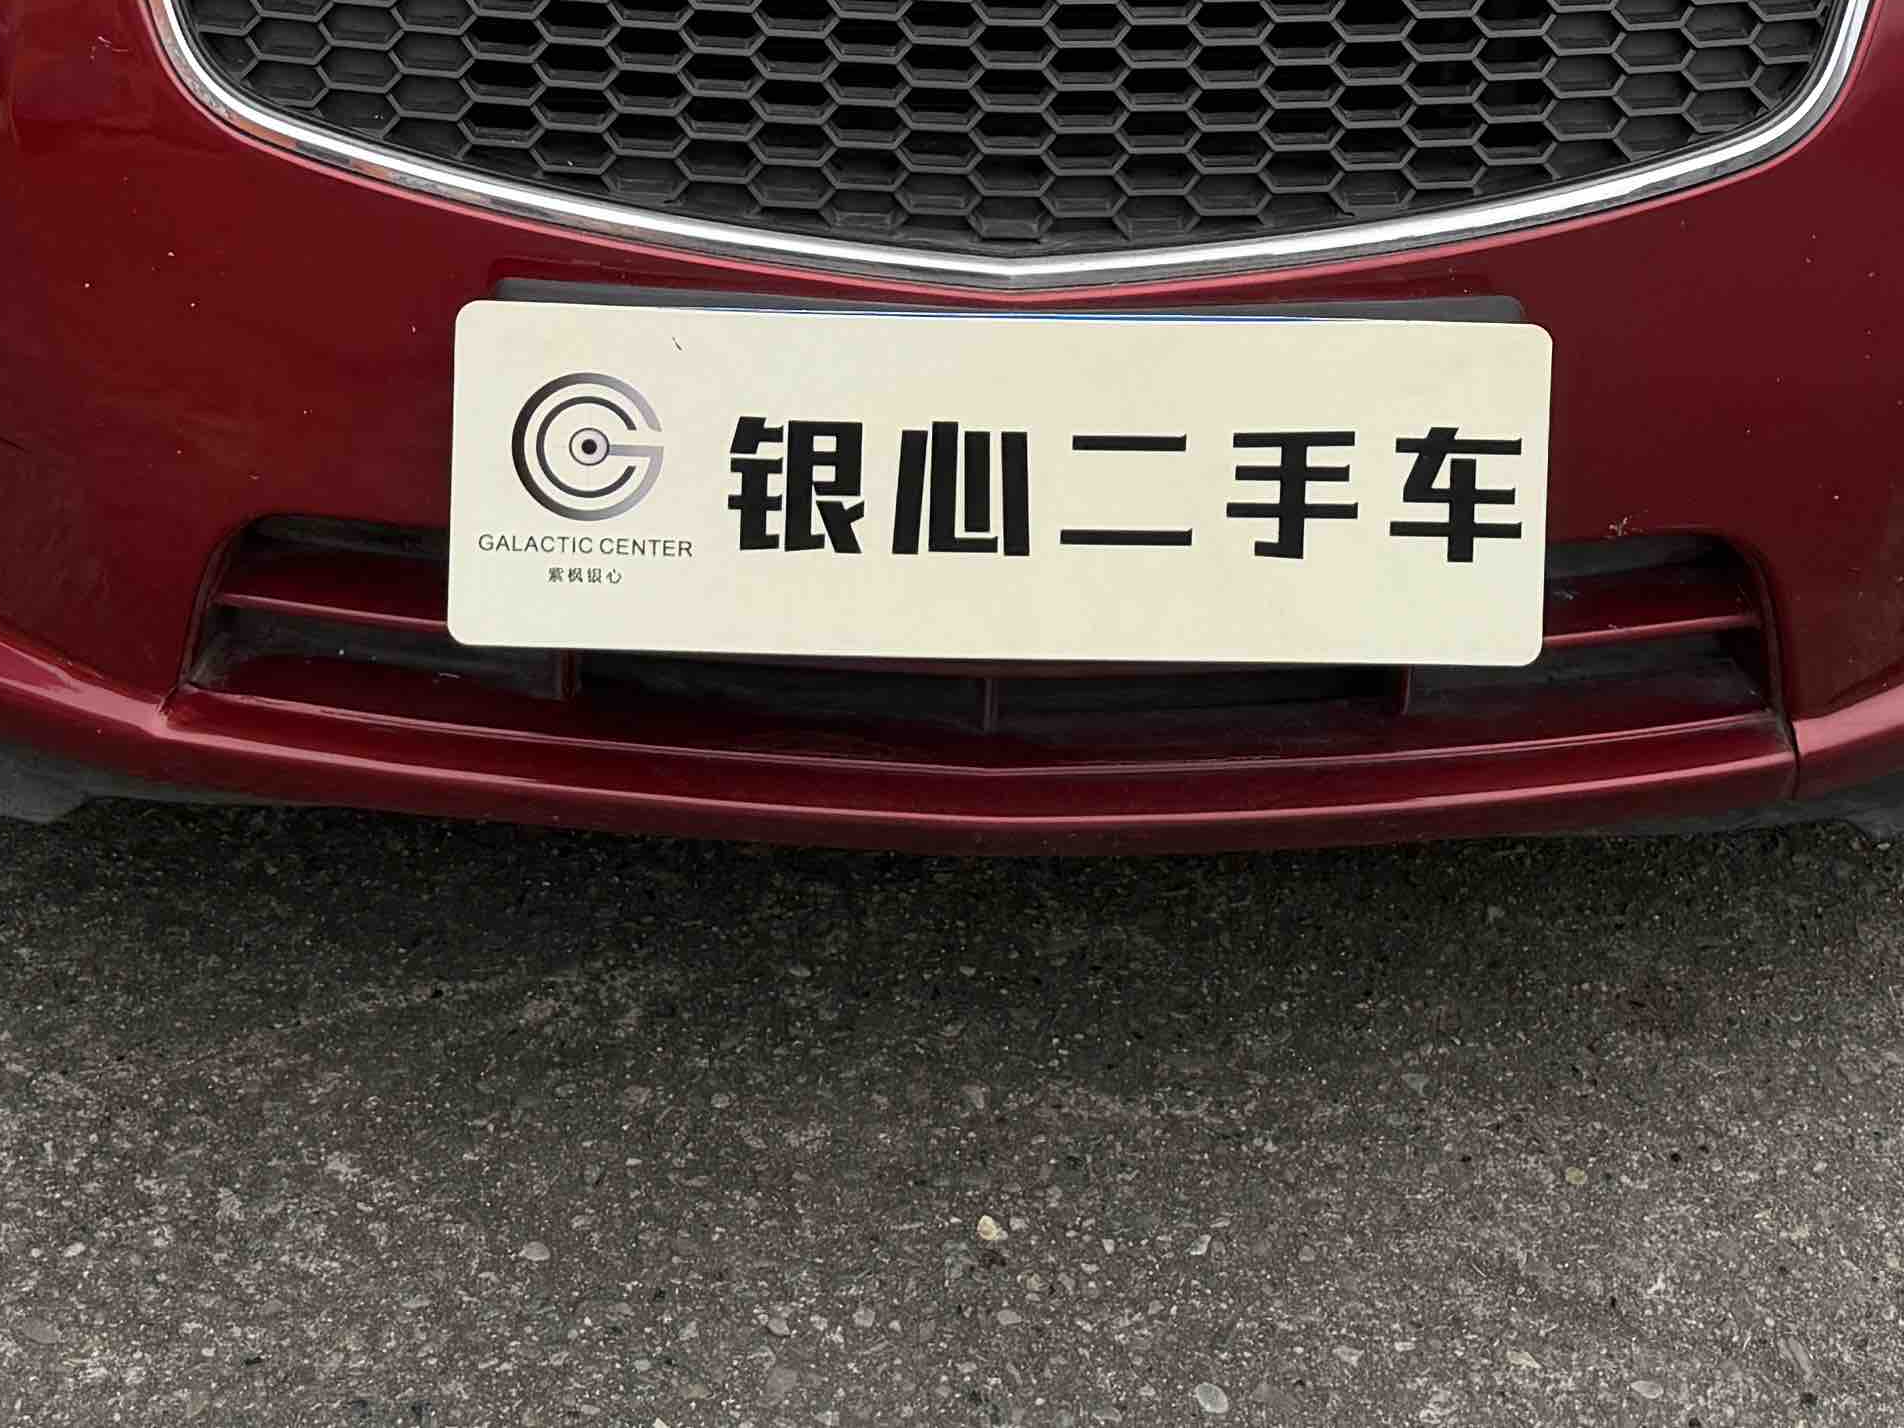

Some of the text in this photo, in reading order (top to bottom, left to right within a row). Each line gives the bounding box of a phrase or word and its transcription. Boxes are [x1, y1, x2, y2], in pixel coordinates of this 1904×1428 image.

[727, 416, 1523, 563] 银心二手车
[478, 534, 694, 557] GALACTIC CENTER
[548, 567, 622, 585] 紫枫银心
